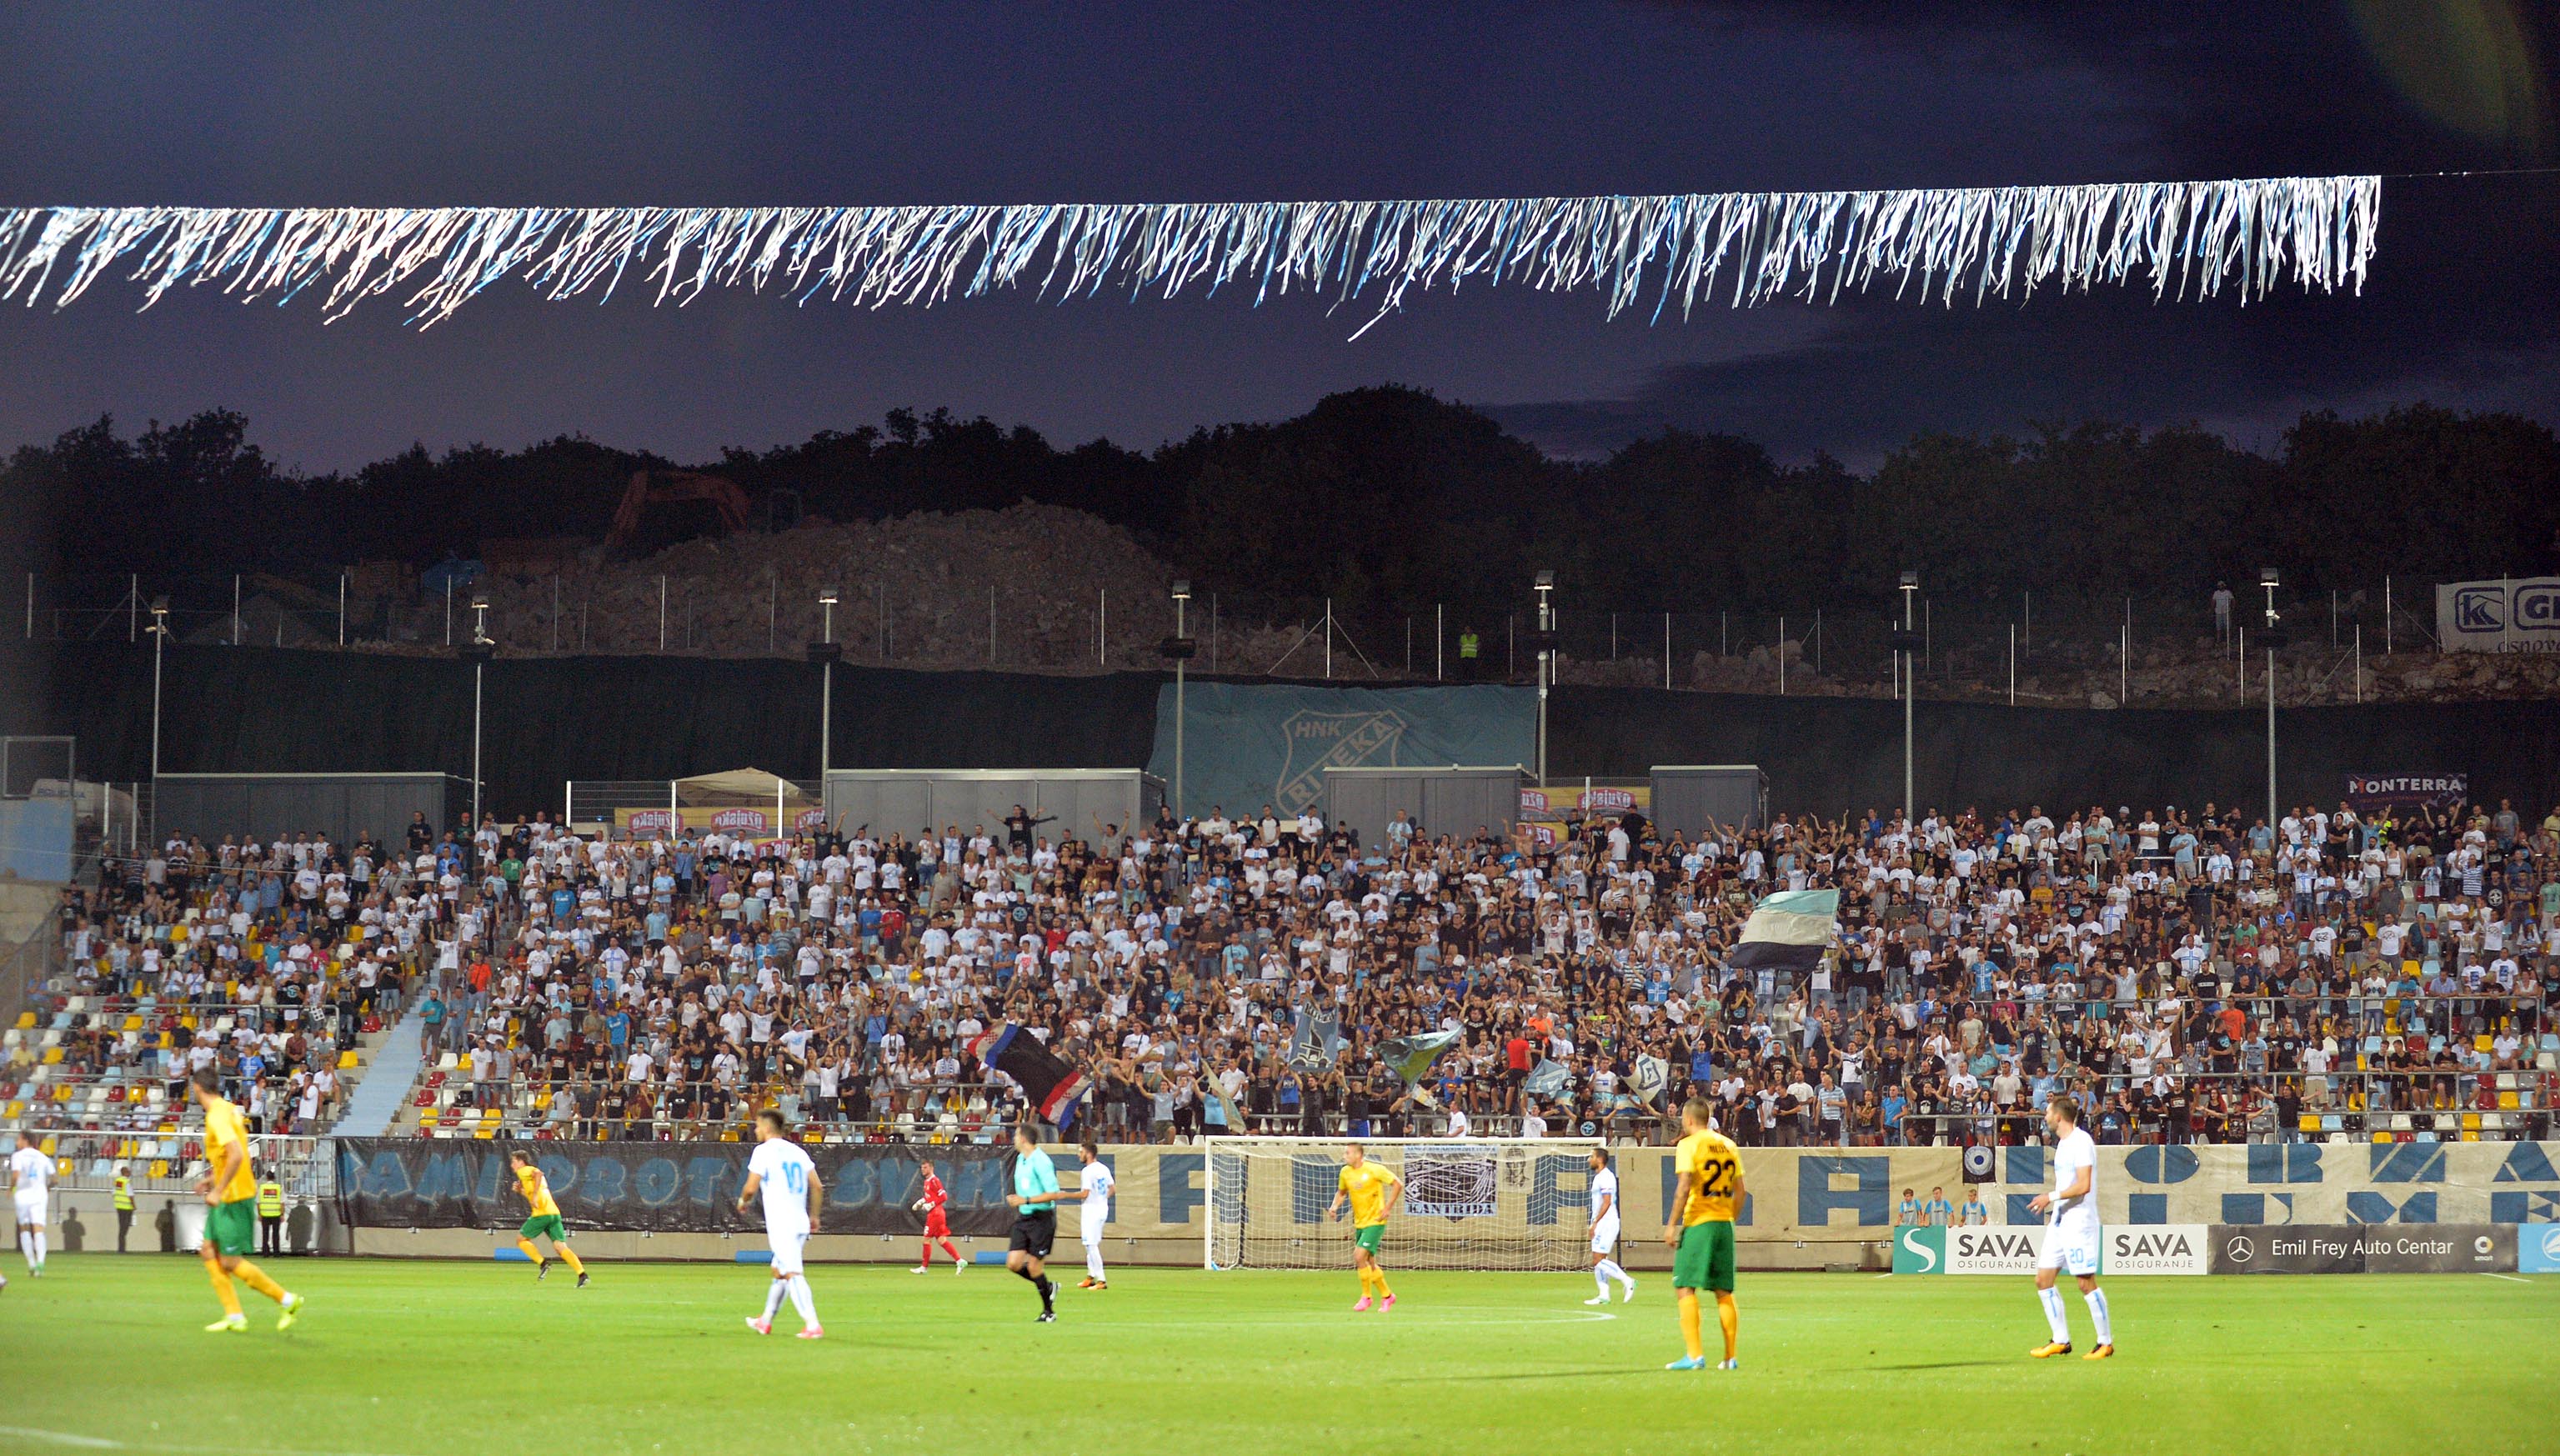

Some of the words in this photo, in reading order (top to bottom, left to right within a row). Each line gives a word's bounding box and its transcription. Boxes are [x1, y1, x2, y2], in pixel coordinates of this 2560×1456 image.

[2525, 593, 2560, 620] G
[1295, 720, 1342, 738] HNK
[1287, 720, 1395, 805] RIEKA
[2349, 778, 2462, 794] MONTERRA
[535, 1153, 752, 1210] PROT
[781, 1161, 804, 1193] 10
[1703, 1159, 1736, 1198] 23
[1407, 1203, 1494, 1214] KANTRIDA
[1958, 1234, 2036, 1258] SAVA
[2070, 1248, 2085, 1264] 20
[2115, 1234, 2193, 1258] SAVA
[2272, 1239, 2307, 1256] Emil
[2312, 1239, 2347, 1258] Frey
[2352, 1238, 2392, 1255] Auto
[2397, 1238, 2454, 1254] Centar
[1957, 1259, 2036, 1269] OSIGURANJE
[2115, 1259, 2194, 1269] OSIGURANJE
